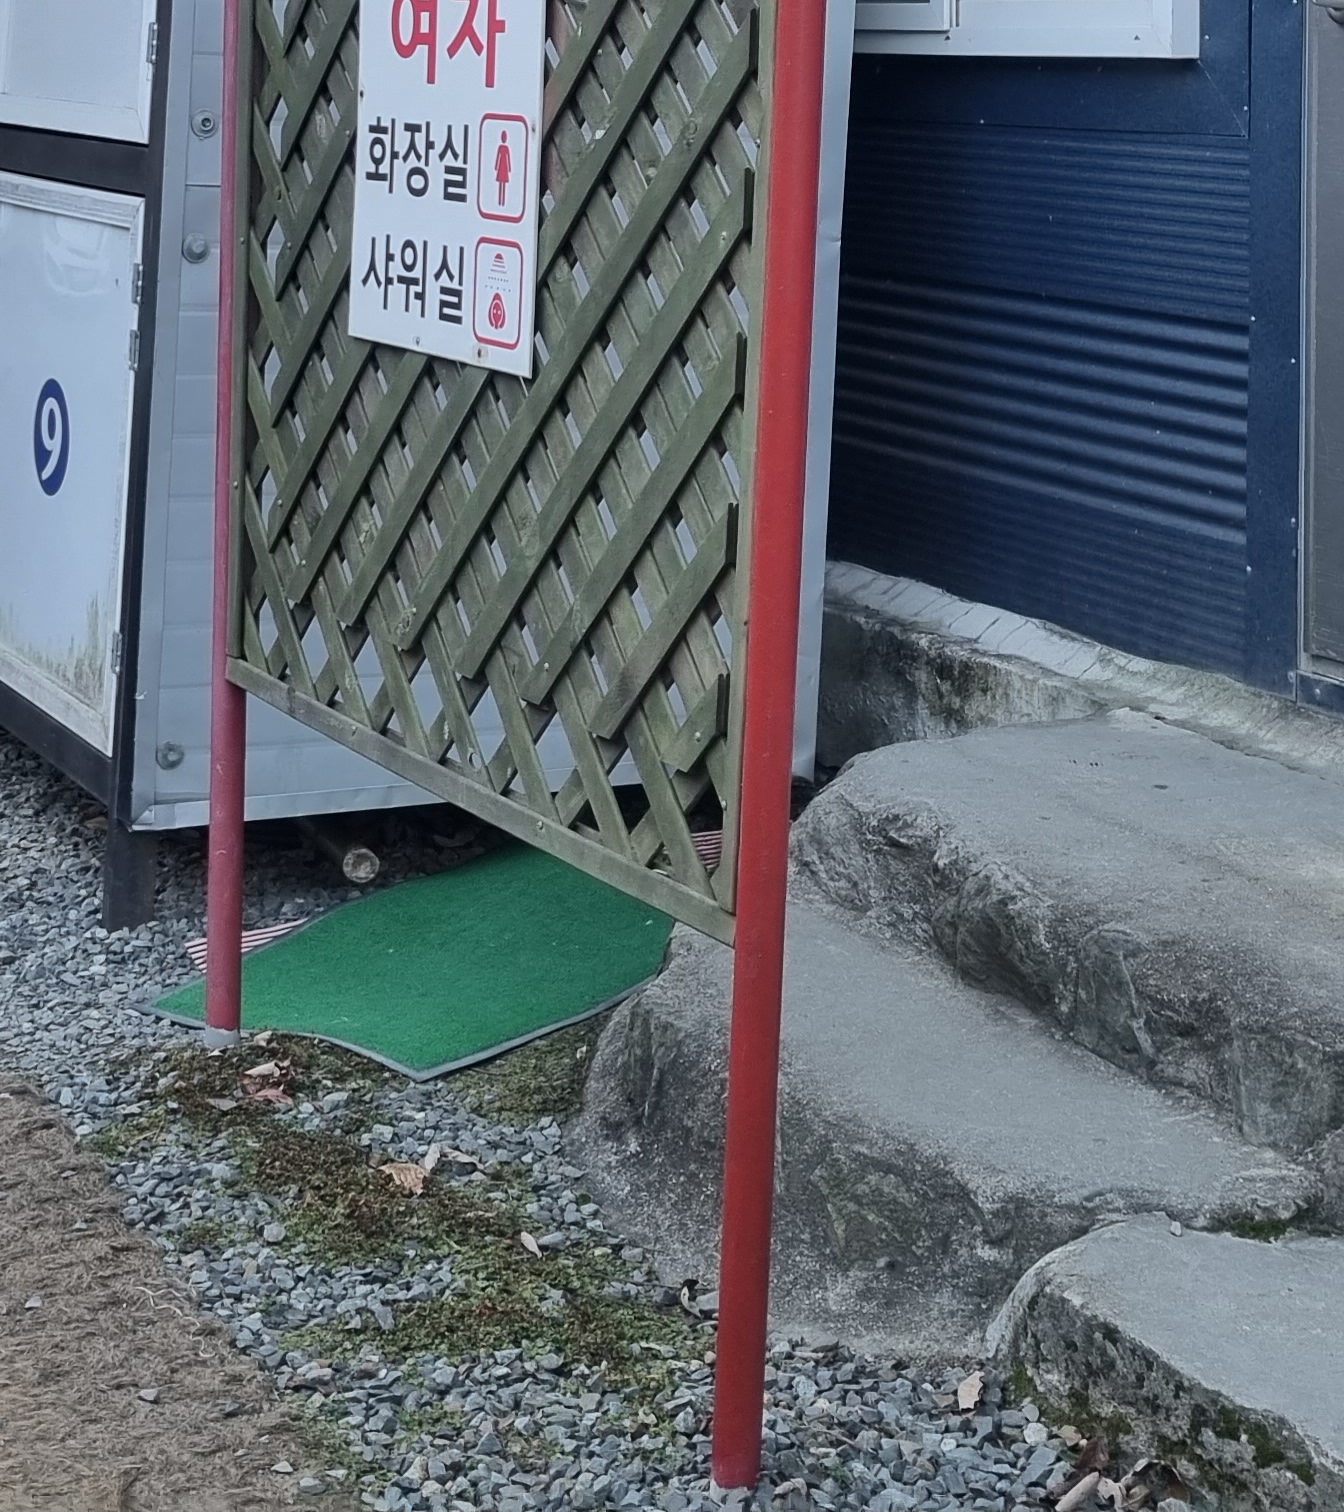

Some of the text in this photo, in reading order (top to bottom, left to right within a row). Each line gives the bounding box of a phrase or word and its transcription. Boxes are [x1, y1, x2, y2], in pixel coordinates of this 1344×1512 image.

[365, 116, 470, 203] 화장실
[361, 233, 465, 325] 샤워실
[40, 396, 63, 481] 9
